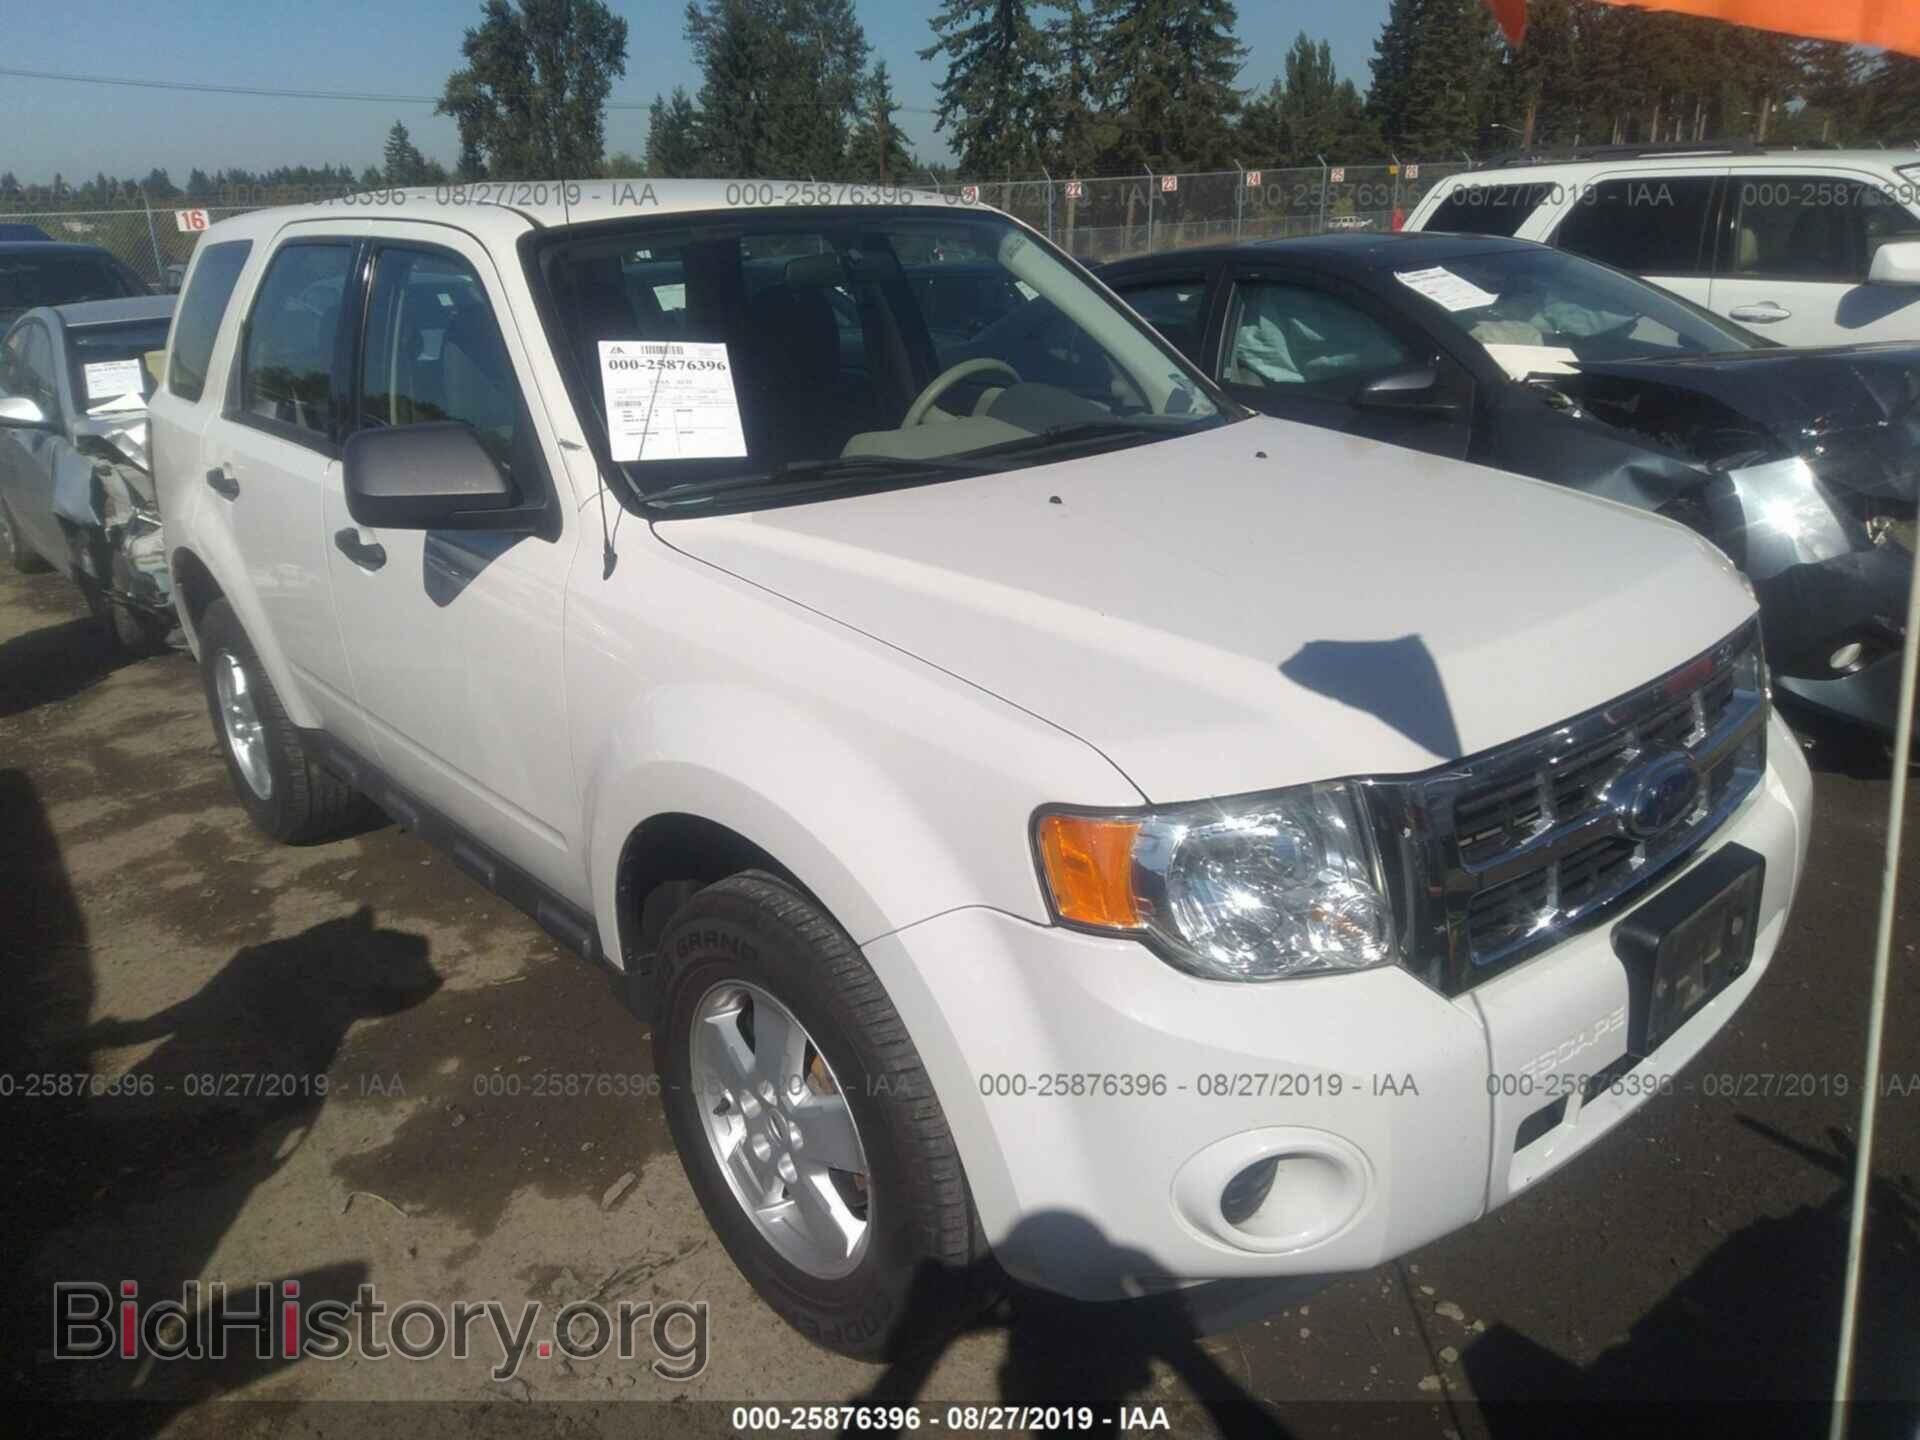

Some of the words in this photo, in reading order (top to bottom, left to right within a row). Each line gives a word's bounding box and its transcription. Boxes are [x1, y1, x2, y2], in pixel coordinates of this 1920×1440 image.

[1163, 177, 1176, 190] 23
[1248, 172, 1260, 184] 24
[1066, 183, 1081, 196] 22
[182, 211, 205, 231] 16
[608, 358, 727, 372] 000-25876396
